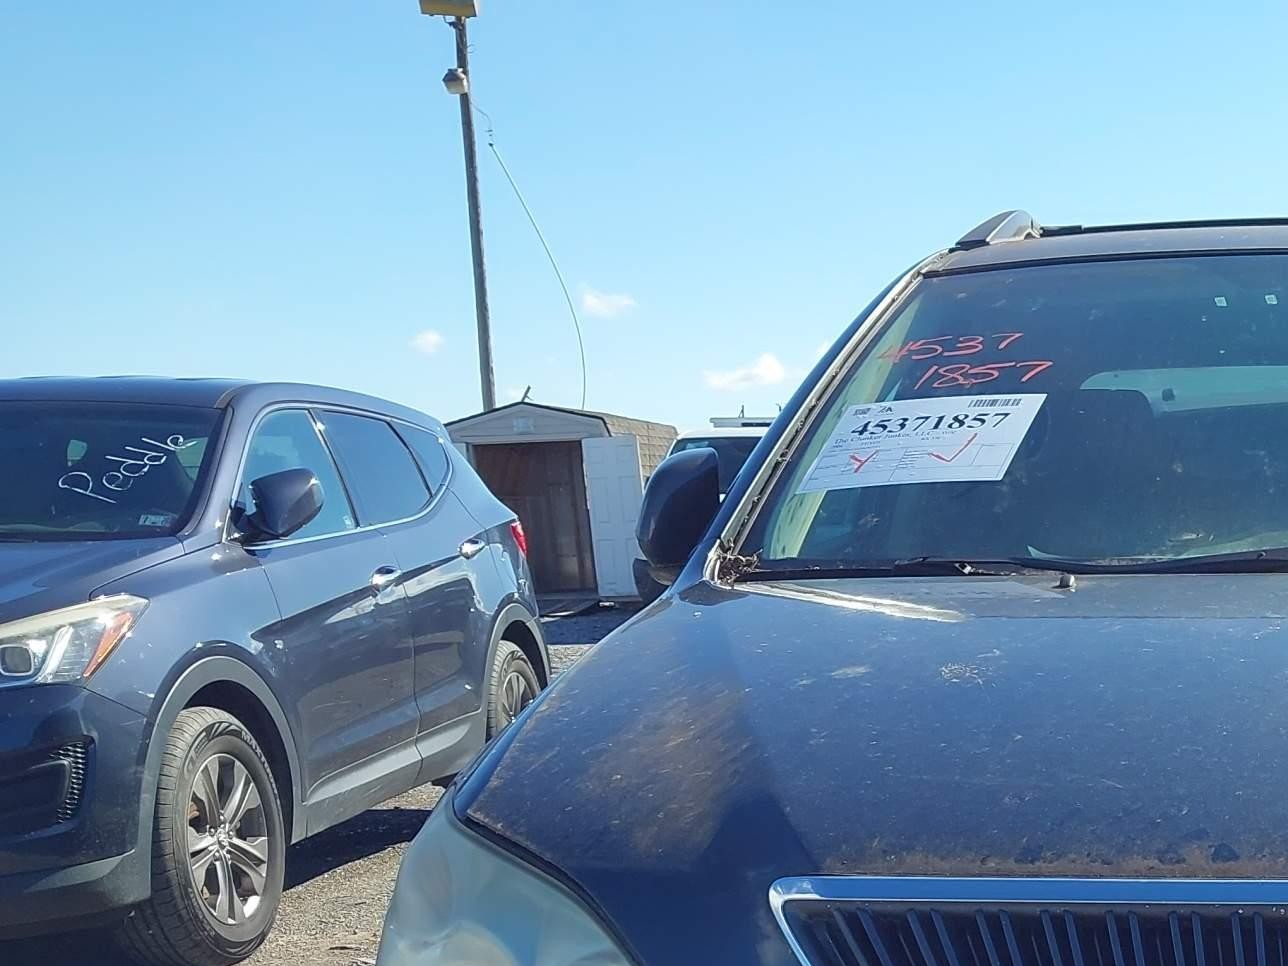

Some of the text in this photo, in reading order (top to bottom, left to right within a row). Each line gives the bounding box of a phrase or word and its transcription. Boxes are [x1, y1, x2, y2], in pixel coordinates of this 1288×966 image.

[877, 332, 1025, 363] 4537
[914, 361, 1054, 390] 1857
[851, 412, 1012, 437] 45371857
[58, 433, 198, 504] Peddle
